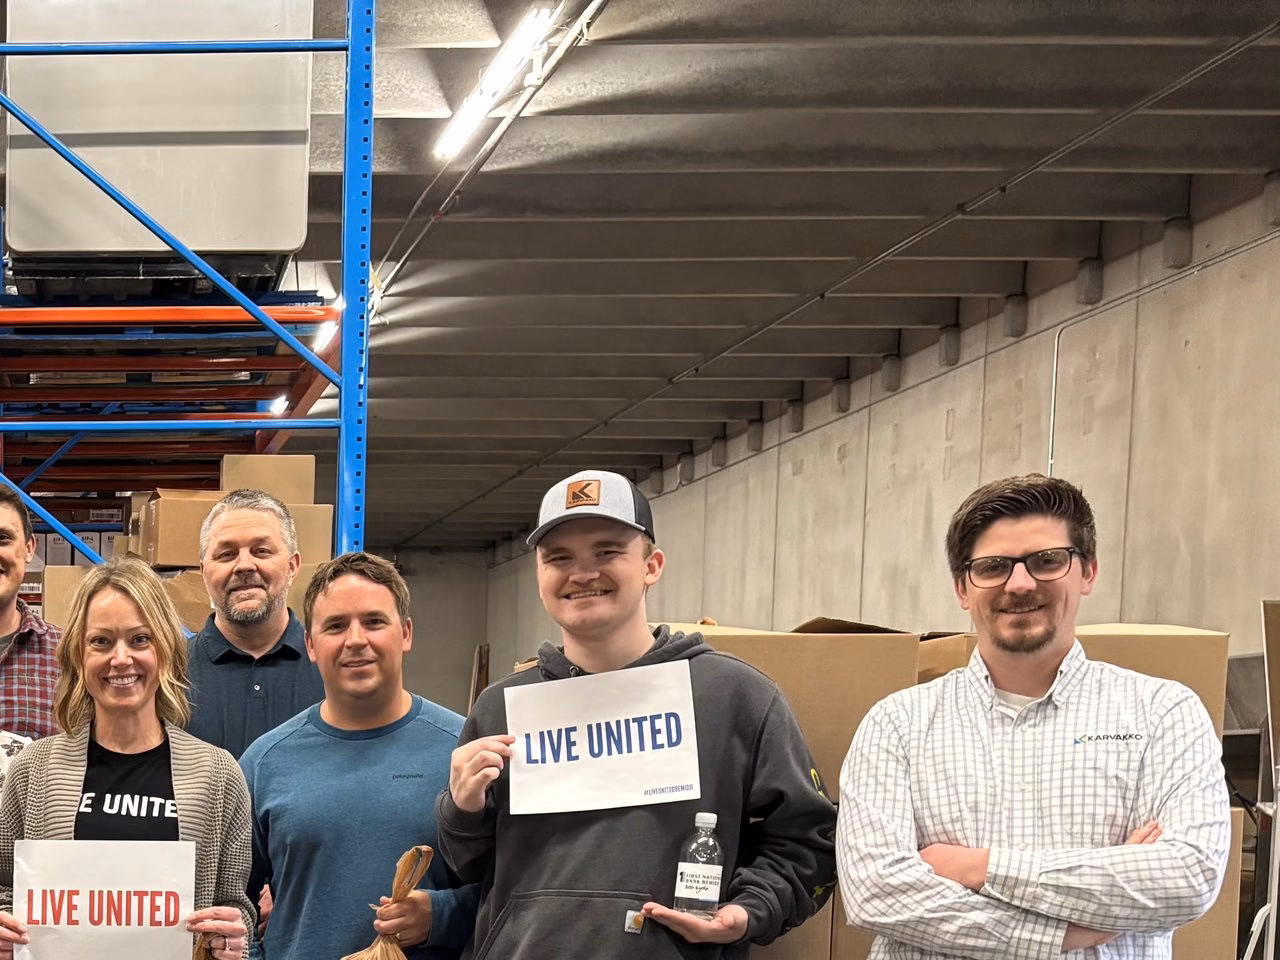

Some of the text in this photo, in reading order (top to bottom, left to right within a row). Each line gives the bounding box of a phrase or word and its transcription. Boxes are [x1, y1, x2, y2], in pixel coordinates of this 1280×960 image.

[524, 711, 683, 765] LIVE UNITED
[1088, 733, 1143, 742] KARVAKKO
[27, 889, 180, 927] LIVE UNITED
